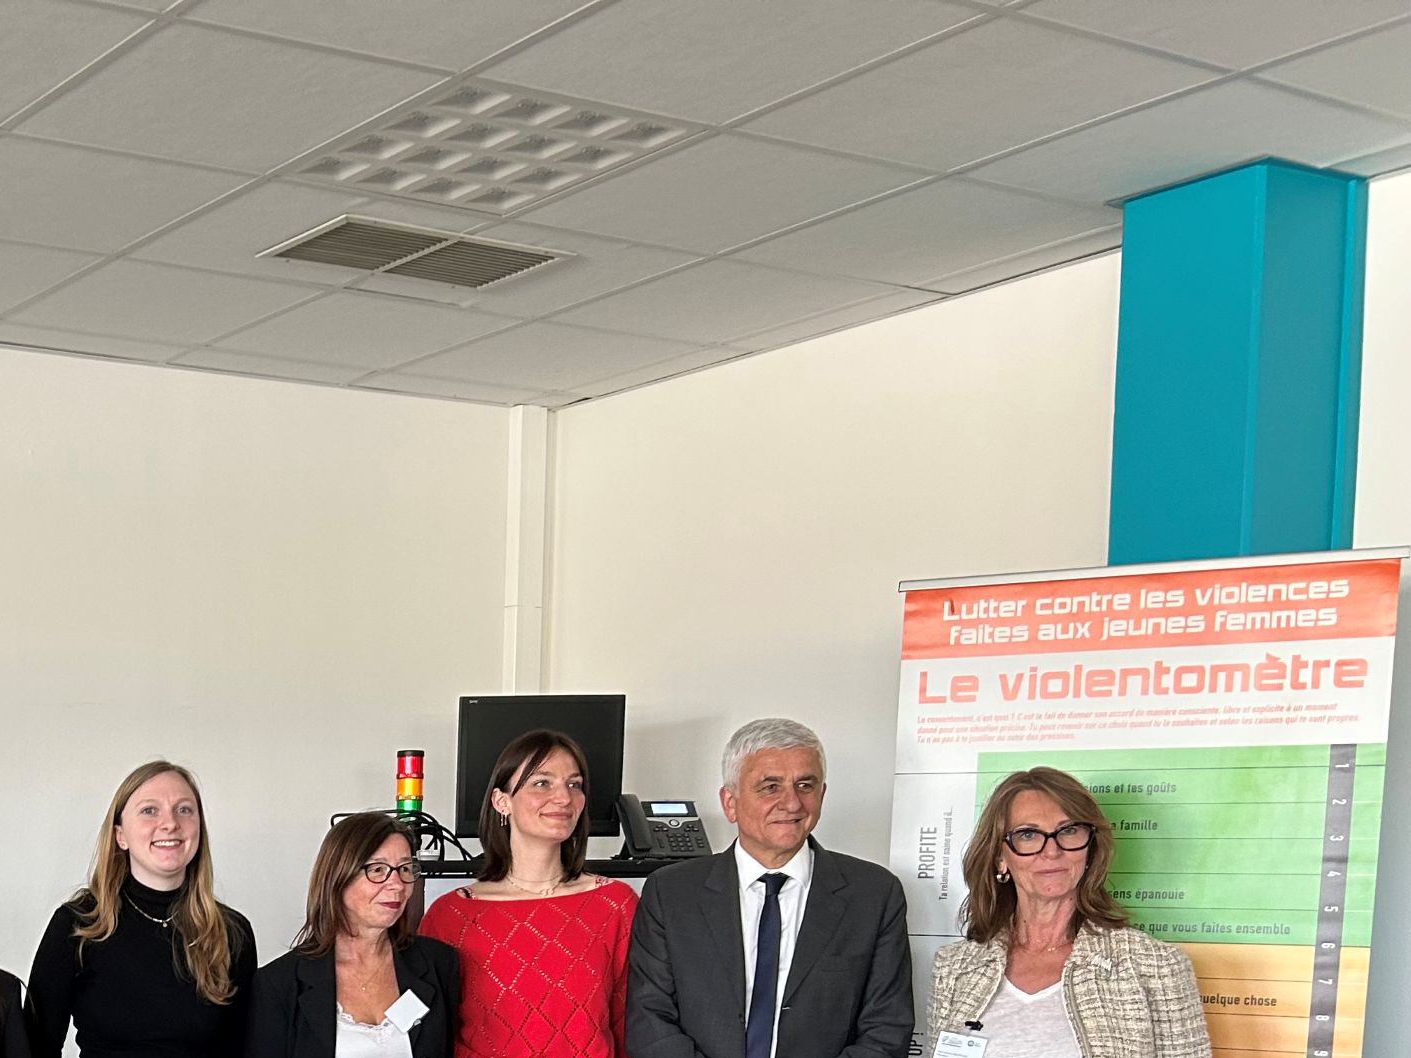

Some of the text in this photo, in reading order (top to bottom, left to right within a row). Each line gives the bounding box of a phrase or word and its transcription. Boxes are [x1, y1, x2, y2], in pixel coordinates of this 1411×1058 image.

[943, 579, 1350, 621] Lutter contre les violences
[950, 607, 1338, 646] faites aux jeunes femmes
[918, 652, 1369, 704] Le violentomètre
[1113, 784, 1125, 794] et
[1127, 784, 1143, 794] tes
[1147, 781, 1177, 795] goûts
[1332, 798, 1347, 806] 2
[1120, 819, 1157, 831] famille
[1329, 834, 1345, 842] 3
[917, 827, 937, 879] PROFITE
[1327, 870, 1341, 878] 4
[1135, 888, 1185, 902] épanouie
[1148, 923, 1169, 934] que
[1172, 923, 1198, 933] vous
[1201, 921, 1233, 934] faites
[1235, 922, 1291, 936] ensemble
[1321, 942, 1336, 950] 6
[1318, 978, 1333, 986] 7
[1243, 995, 1277, 1006] chose
[1315, 1014, 1330, 1022] 8
